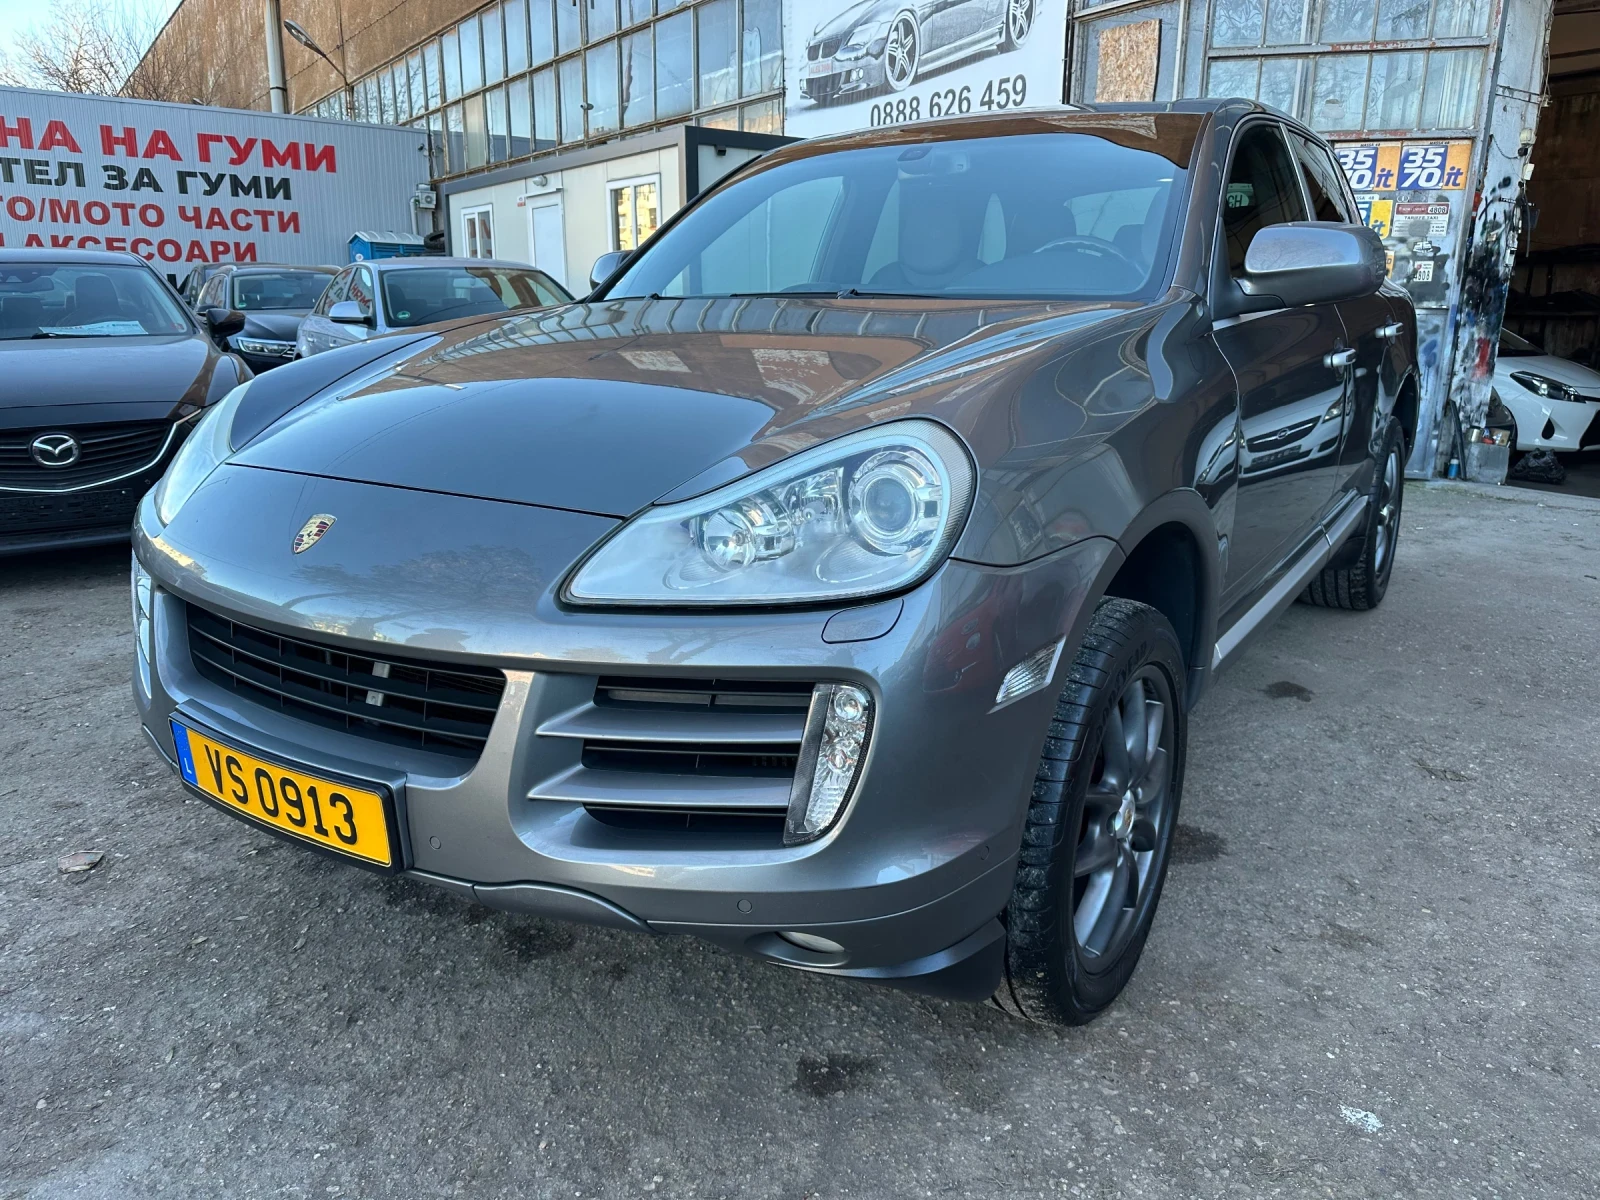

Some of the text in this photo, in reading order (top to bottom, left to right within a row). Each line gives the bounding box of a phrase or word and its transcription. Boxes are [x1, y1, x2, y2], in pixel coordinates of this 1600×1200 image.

[870, 73, 1027, 127] 0888 626 459
[0, 115, 337, 173] НА НА ГУМИ
[1339, 149, 1376, 170] 35
[1403, 147, 1445, 168] 35
[0, 156, 293, 201] ТЕЛ ЗА ГУМИ
[0, 195, 301, 234] О/МОТО ЧАСТИ
[1429, 206, 1446, 214] 4808
[183, 757, 193, 775] L
[204, 743, 358, 846] VS 0913
